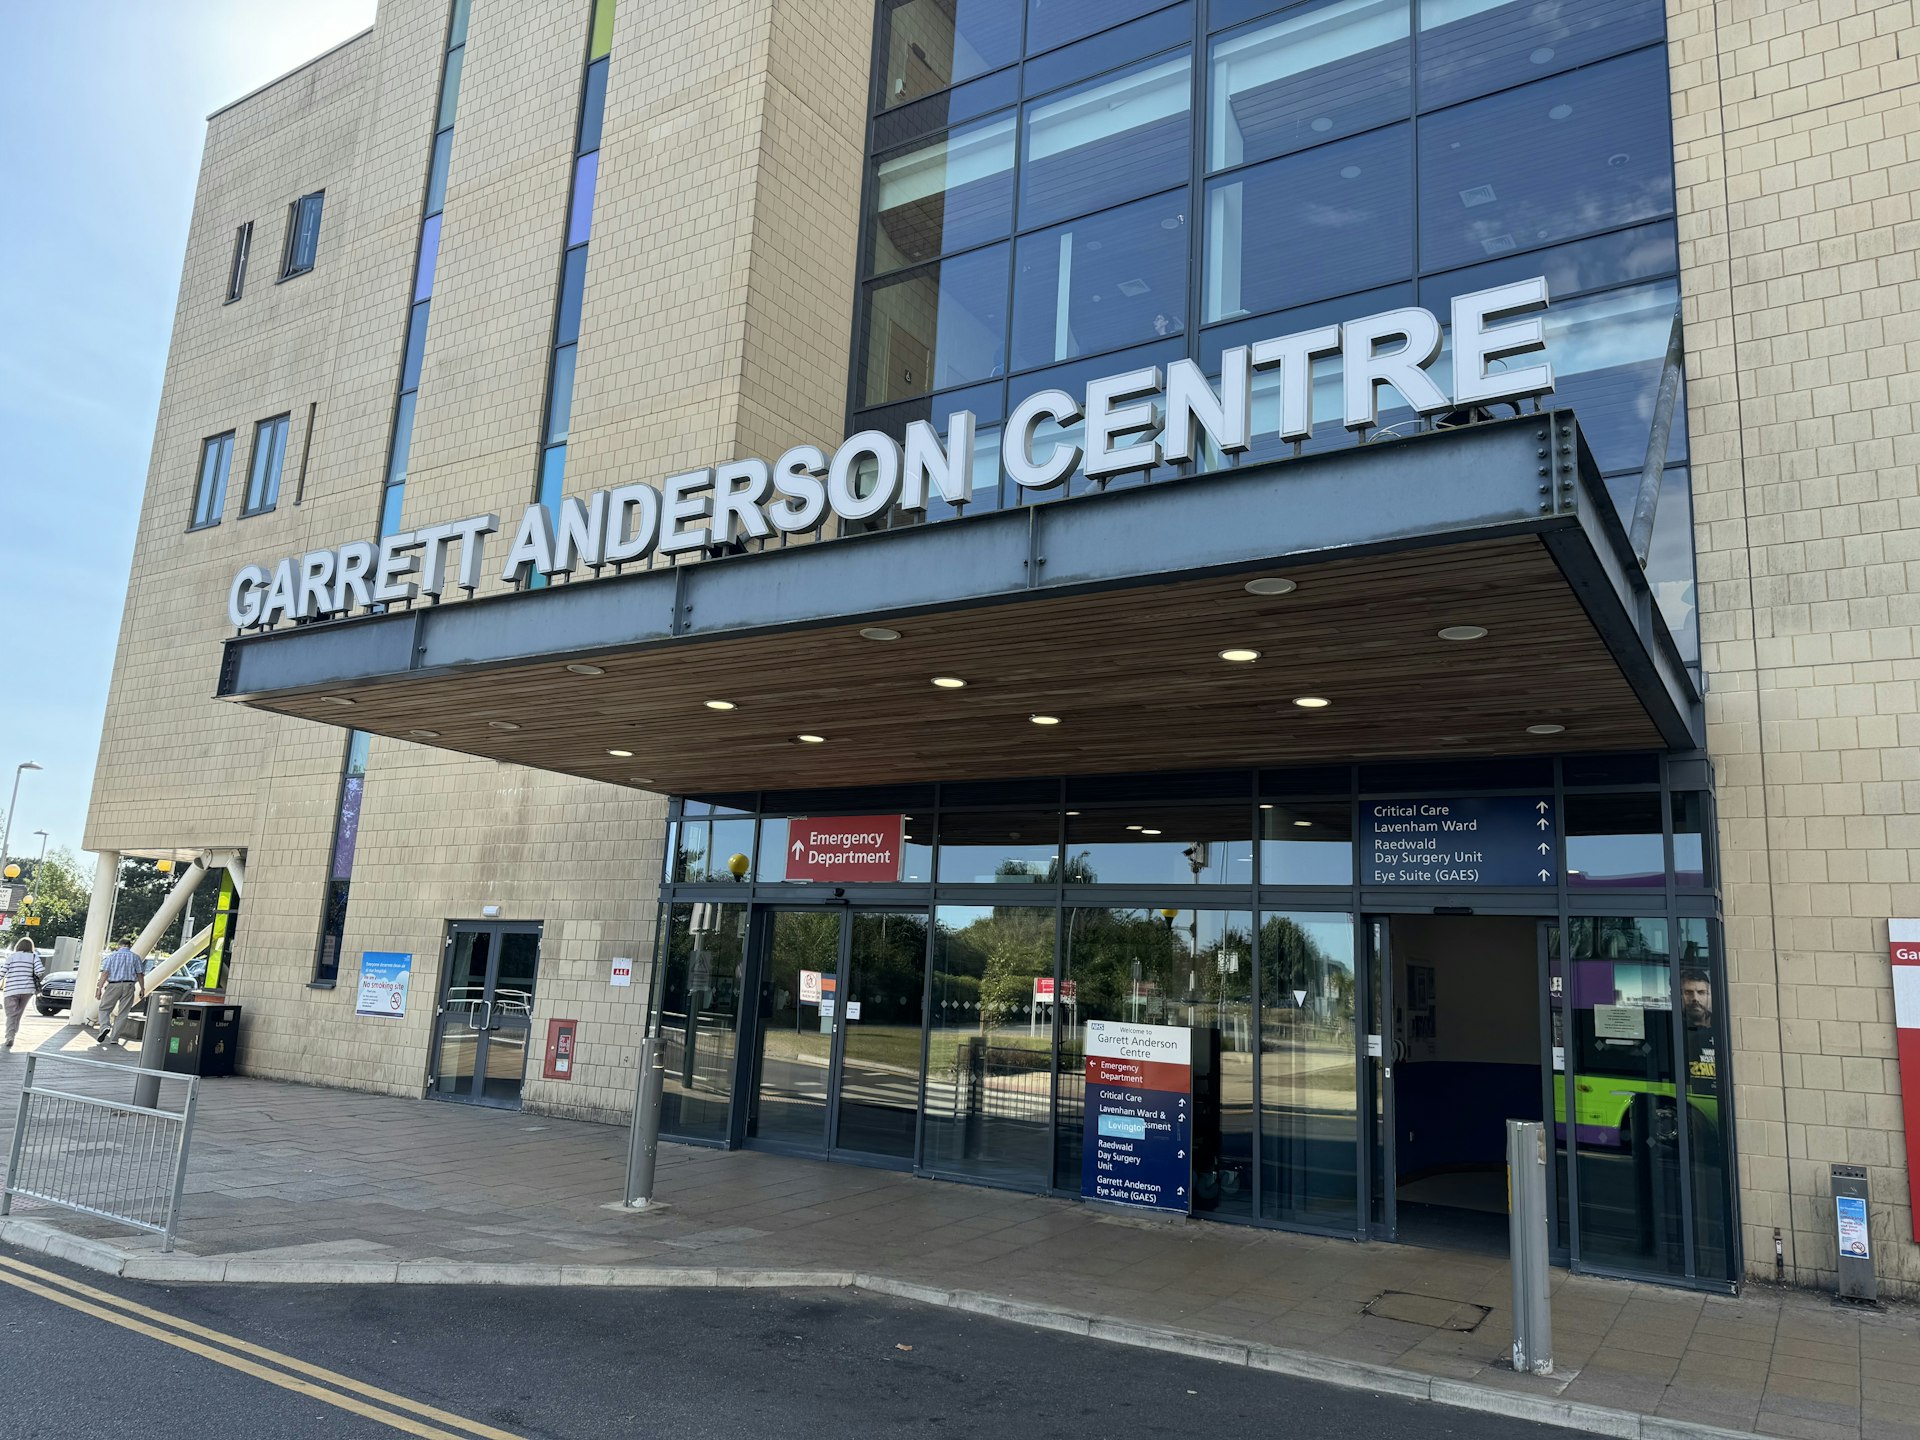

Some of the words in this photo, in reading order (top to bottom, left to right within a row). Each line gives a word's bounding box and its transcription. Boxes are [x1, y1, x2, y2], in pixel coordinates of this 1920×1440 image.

[228, 513, 498, 629] GARRETT
[502, 410, 974, 582] ANDERSON
[1002, 276, 1554, 490] CENTRE
[1374, 805, 1416, 817] Critical
[1420, 804, 1450, 816] Care
[1374, 820, 1438, 833] Lavenham
[1442, 819, 1477, 831] Ward
[809, 831, 884, 848] Emergency
[1374, 838, 1436, 850] Raedwald
[808, 850, 891, 867] Department
[1375, 852, 1398, 865] Day
[1402, 851, 1450, 865] Surgery
[1454, 851, 1483, 863] Unit
[1374, 870, 1396, 883] Eye
[1399, 869, 1431, 881] Suite
[1435, 868, 1479, 882] (GAES)
[1896, 948, 1920, 960] Ga
[371, 981, 393, 991] smoking
[1120, 1027, 1145, 1035] Welcome
[1098, 1033, 1129, 1045] Garrett
[1131, 1036, 1178, 1049] Anderson
[1120, 1046, 1151, 1058] Centre
[1101, 1061, 1139, 1073] Emergency
[1101, 1071, 1143, 1083] Department
[1100, 1090, 1123, 1101] Critical
[1125, 1093, 1142, 1102] Care
[1100, 1104, 1135, 1116] Lavenham
[1137, 1109, 1158, 1119] Ward
[1160, 1111, 1166, 1119] &
[1098, 1139, 1133, 1152] Raedwald
[1098, 1150, 1111, 1161] Day
[1113, 1152, 1141, 1165] Surgery
[1098, 1161, 1113, 1171] Unit
[1097, 1175, 1122, 1187] Garrett
[1124, 1179, 1161, 1192] Anderson
[1097, 1186, 1109, 1196] Eye
[1110, 1187, 1129, 1199] Suite
[1130, 1192, 1157, 1203] (GAES)
